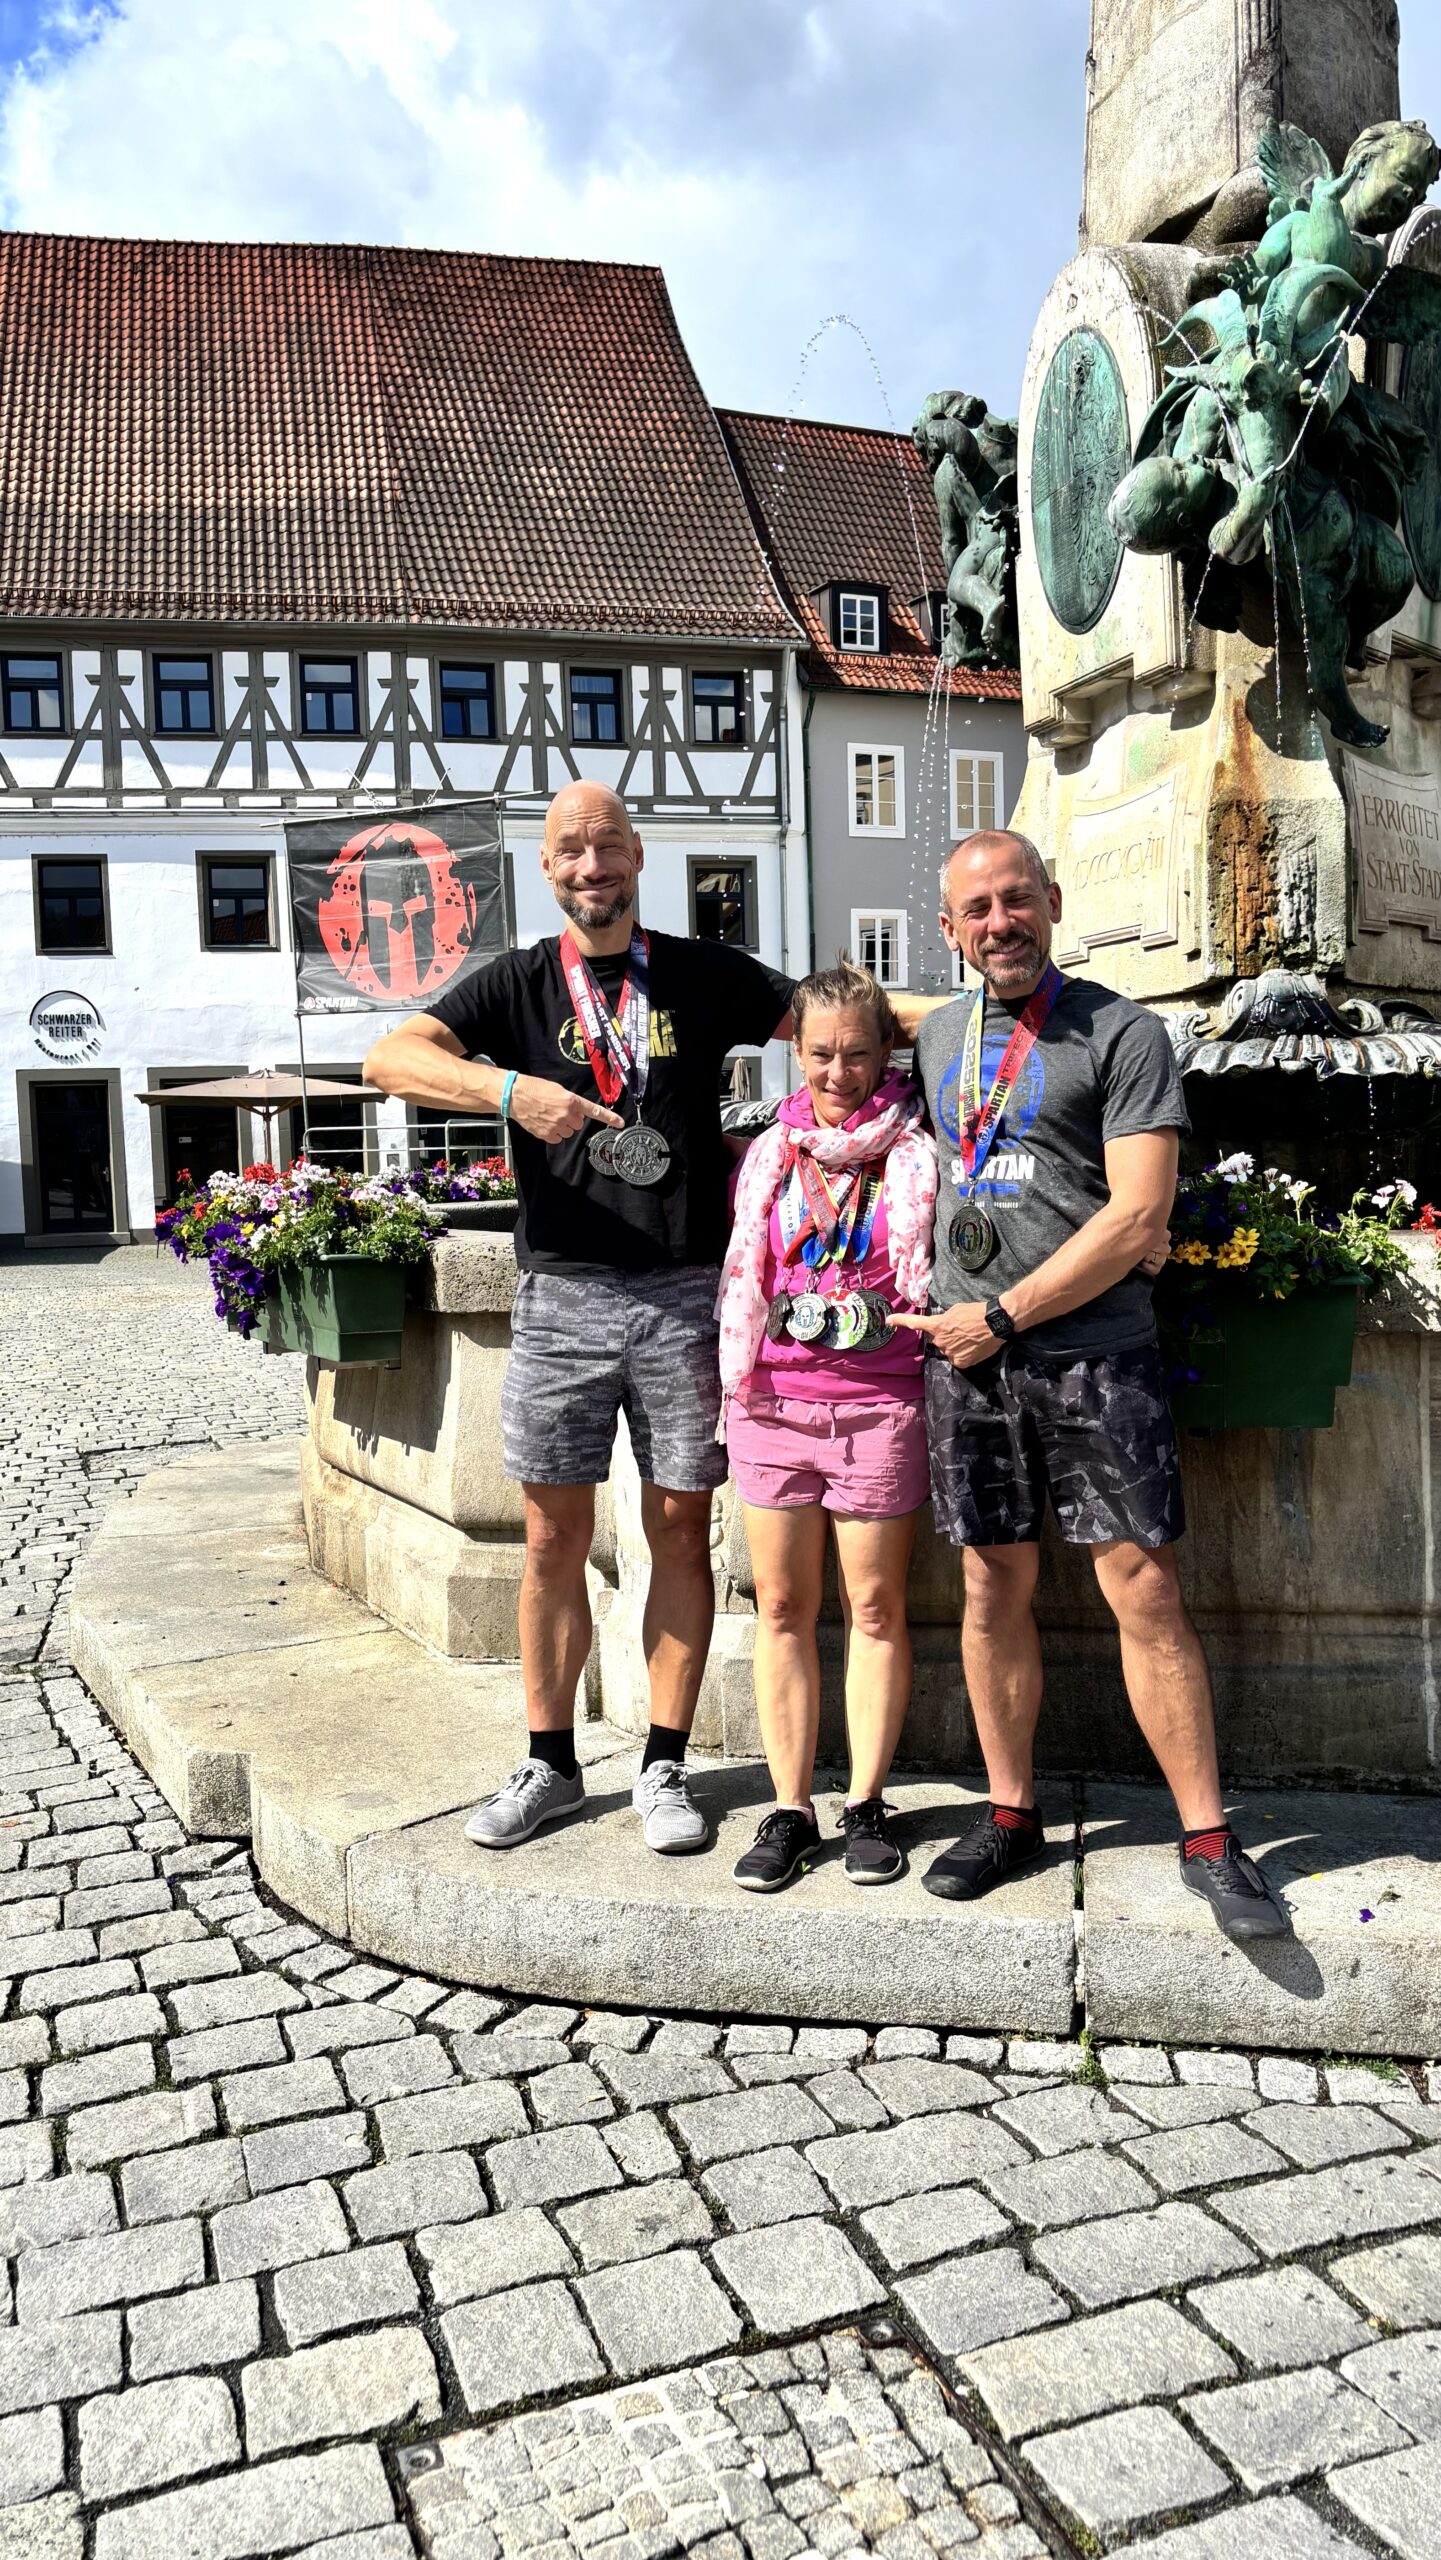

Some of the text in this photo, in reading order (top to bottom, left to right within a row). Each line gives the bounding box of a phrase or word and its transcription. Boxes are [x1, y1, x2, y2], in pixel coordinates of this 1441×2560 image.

[1361, 795, 1439, 841] ERRICHTET
[1399, 836, 1420, 858] VON
[1365, 852, 1441, 901] STAAT STAD
[37, 1013, 92, 1025] SCHWARZER
[315, 996, 359, 1009] SPARTAN
[49, 1026, 83, 1037] REITER
[604, 1021, 631, 1072] FINISHER
[964, 1018, 978, 1085] 2025
[983, 1076, 1011, 1129] SPARTAN
[950, 1154, 1035, 1185] SRTAN
